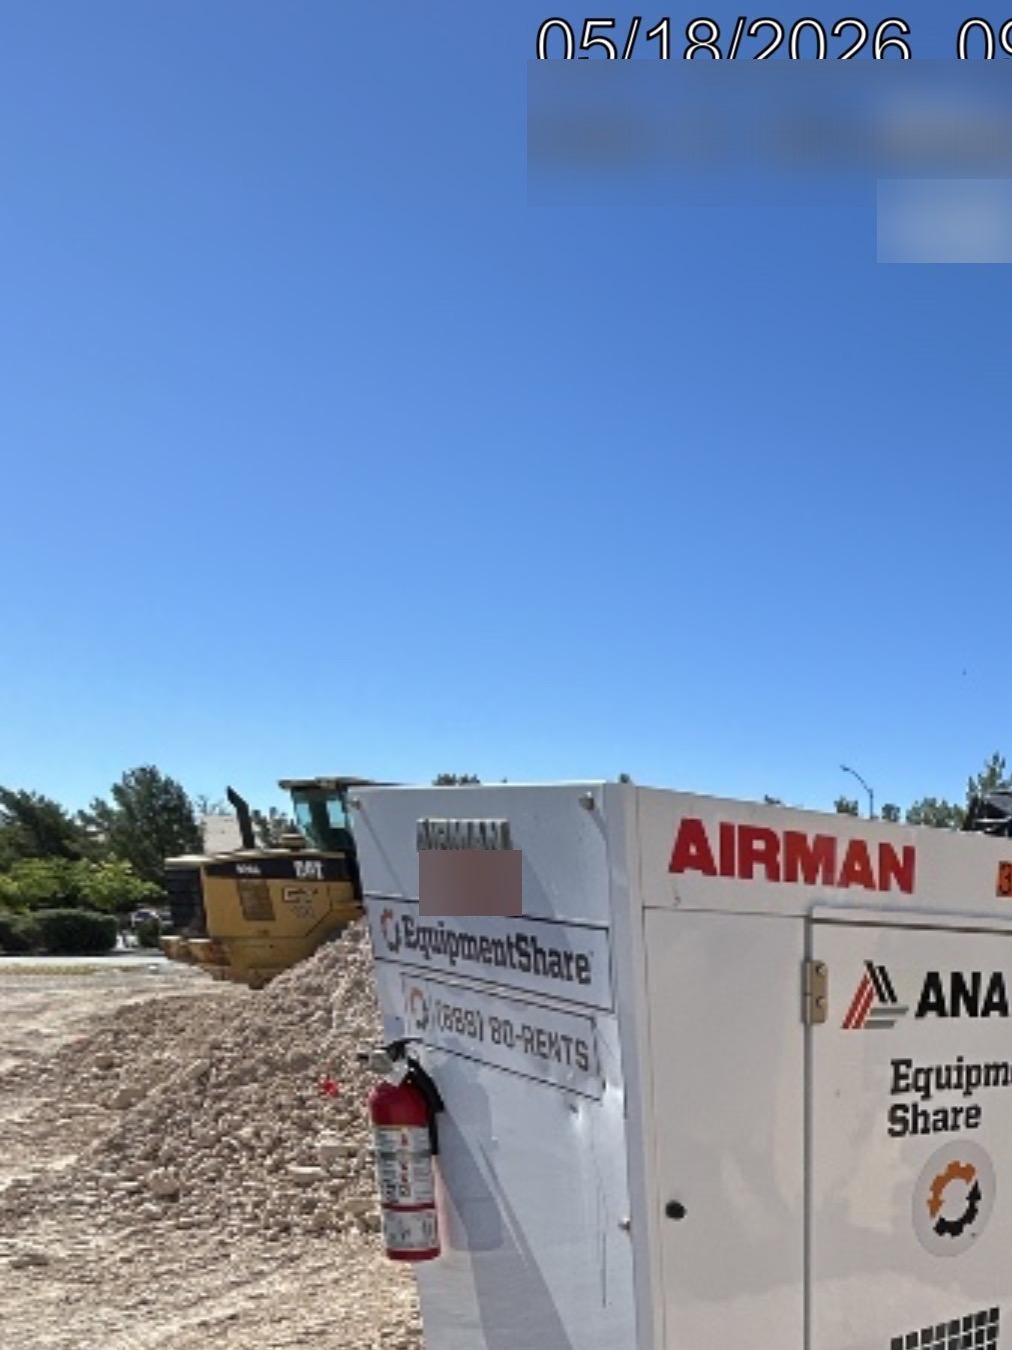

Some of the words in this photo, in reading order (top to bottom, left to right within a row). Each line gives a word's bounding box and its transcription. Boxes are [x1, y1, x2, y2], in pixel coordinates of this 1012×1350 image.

[669, 818, 916, 894] AIRMAN
[401, 915, 592, 985] EquipmentShare
[914, 971, 1010, 1019] ANA
[488, 1016, 589, 1072] 80-RENTS
[887, 1102, 982, 1138] Share
